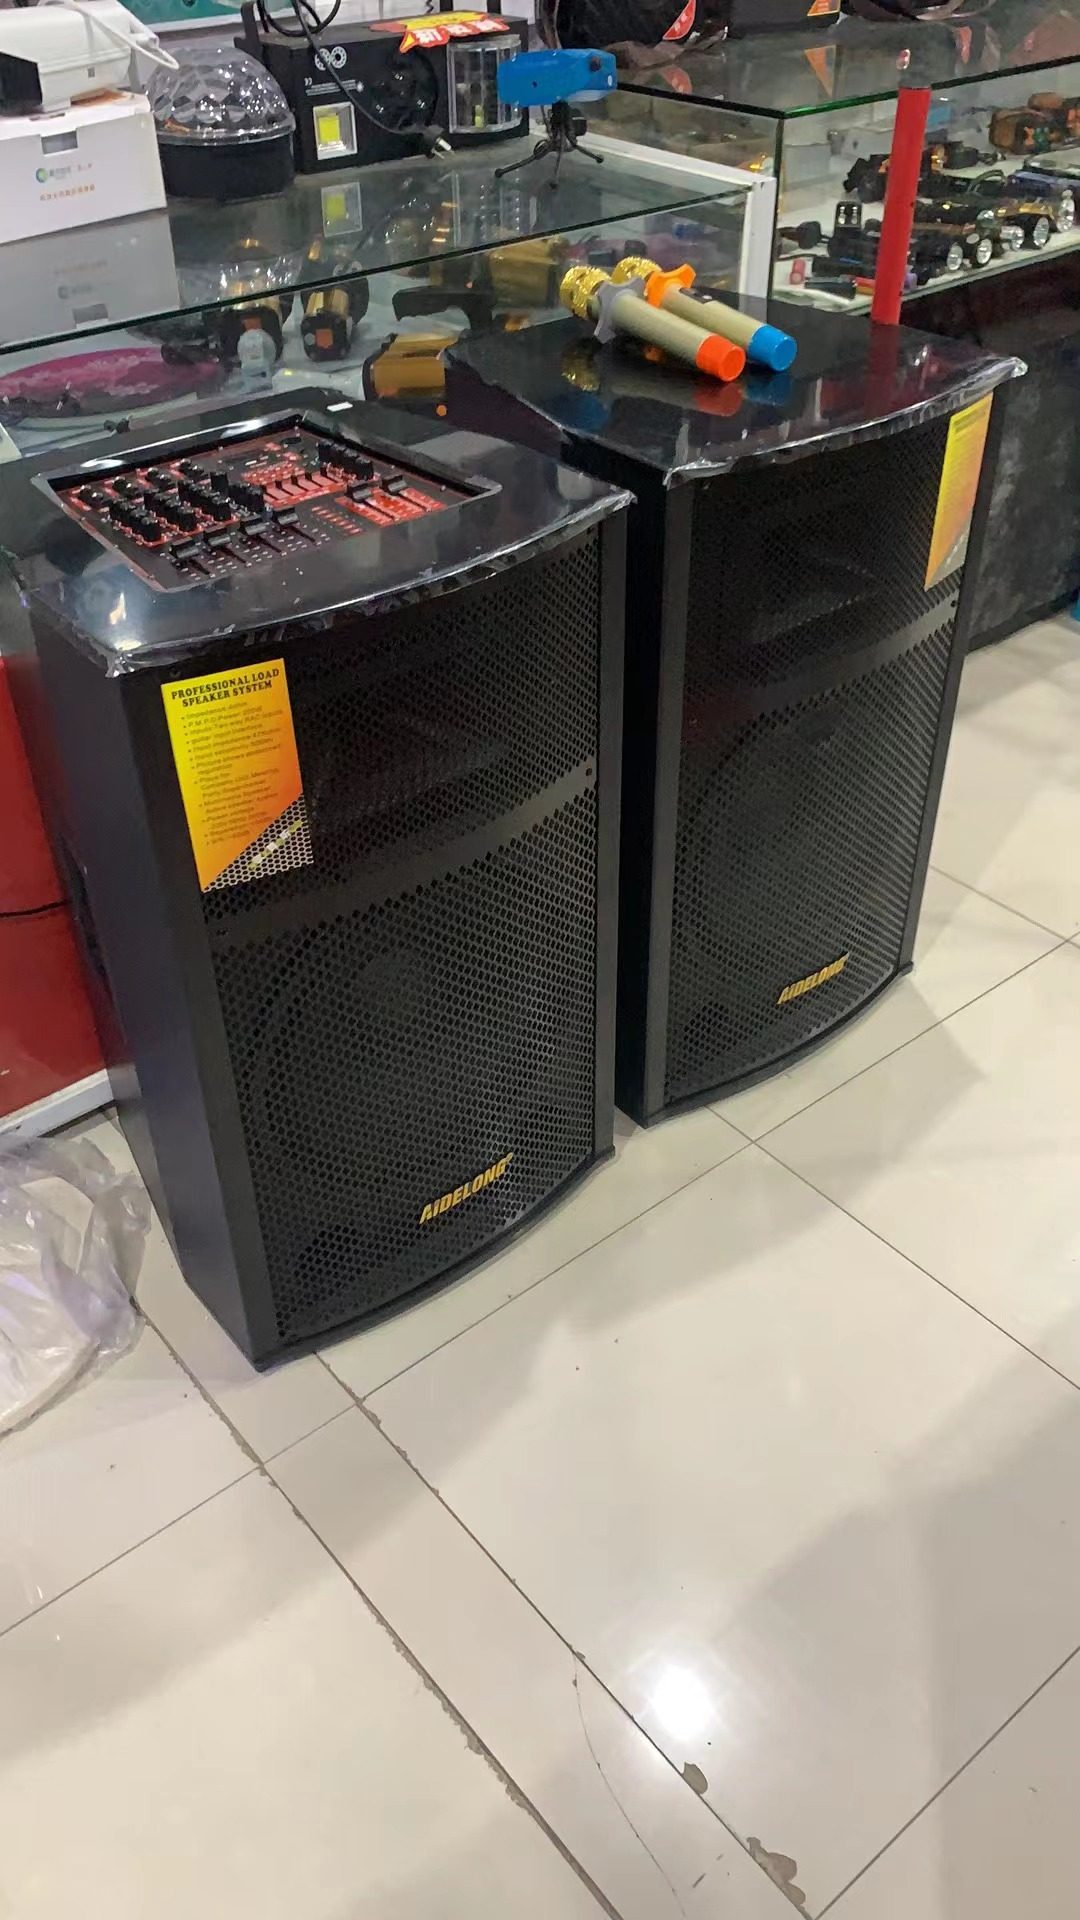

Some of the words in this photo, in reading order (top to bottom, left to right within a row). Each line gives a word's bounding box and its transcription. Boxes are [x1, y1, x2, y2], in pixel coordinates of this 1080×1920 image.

[171, 675, 251, 700] PROFESSIONAL
[252, 668, 281, 682] LOAD
[182, 692, 231, 708] SPEAKER
[232, 680, 273, 697] SYSTEM
[419, 1152, 513, 1225] AIDELONG
